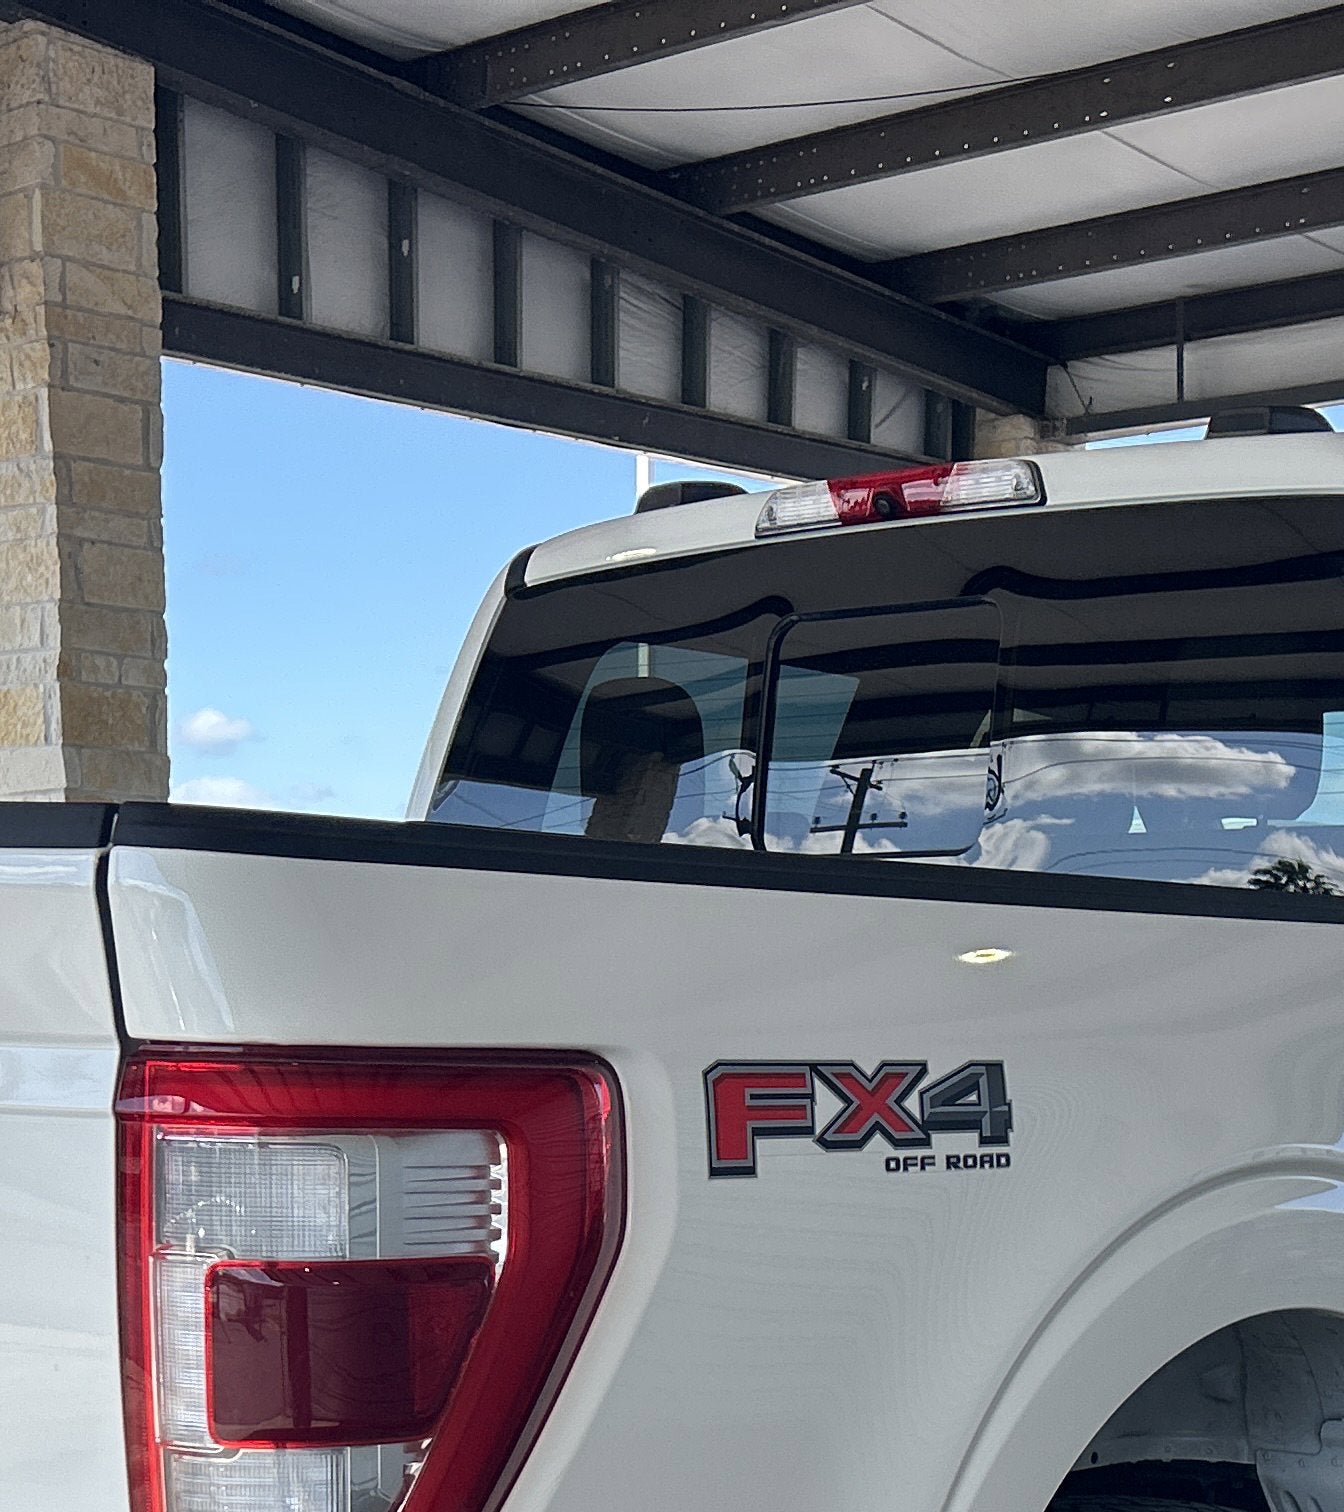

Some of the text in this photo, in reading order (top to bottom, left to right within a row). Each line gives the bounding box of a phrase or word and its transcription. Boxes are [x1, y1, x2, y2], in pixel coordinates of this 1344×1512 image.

[702, 1059, 1013, 1179] FX4
[884, 1152, 1011, 1172] OFF ROAD
